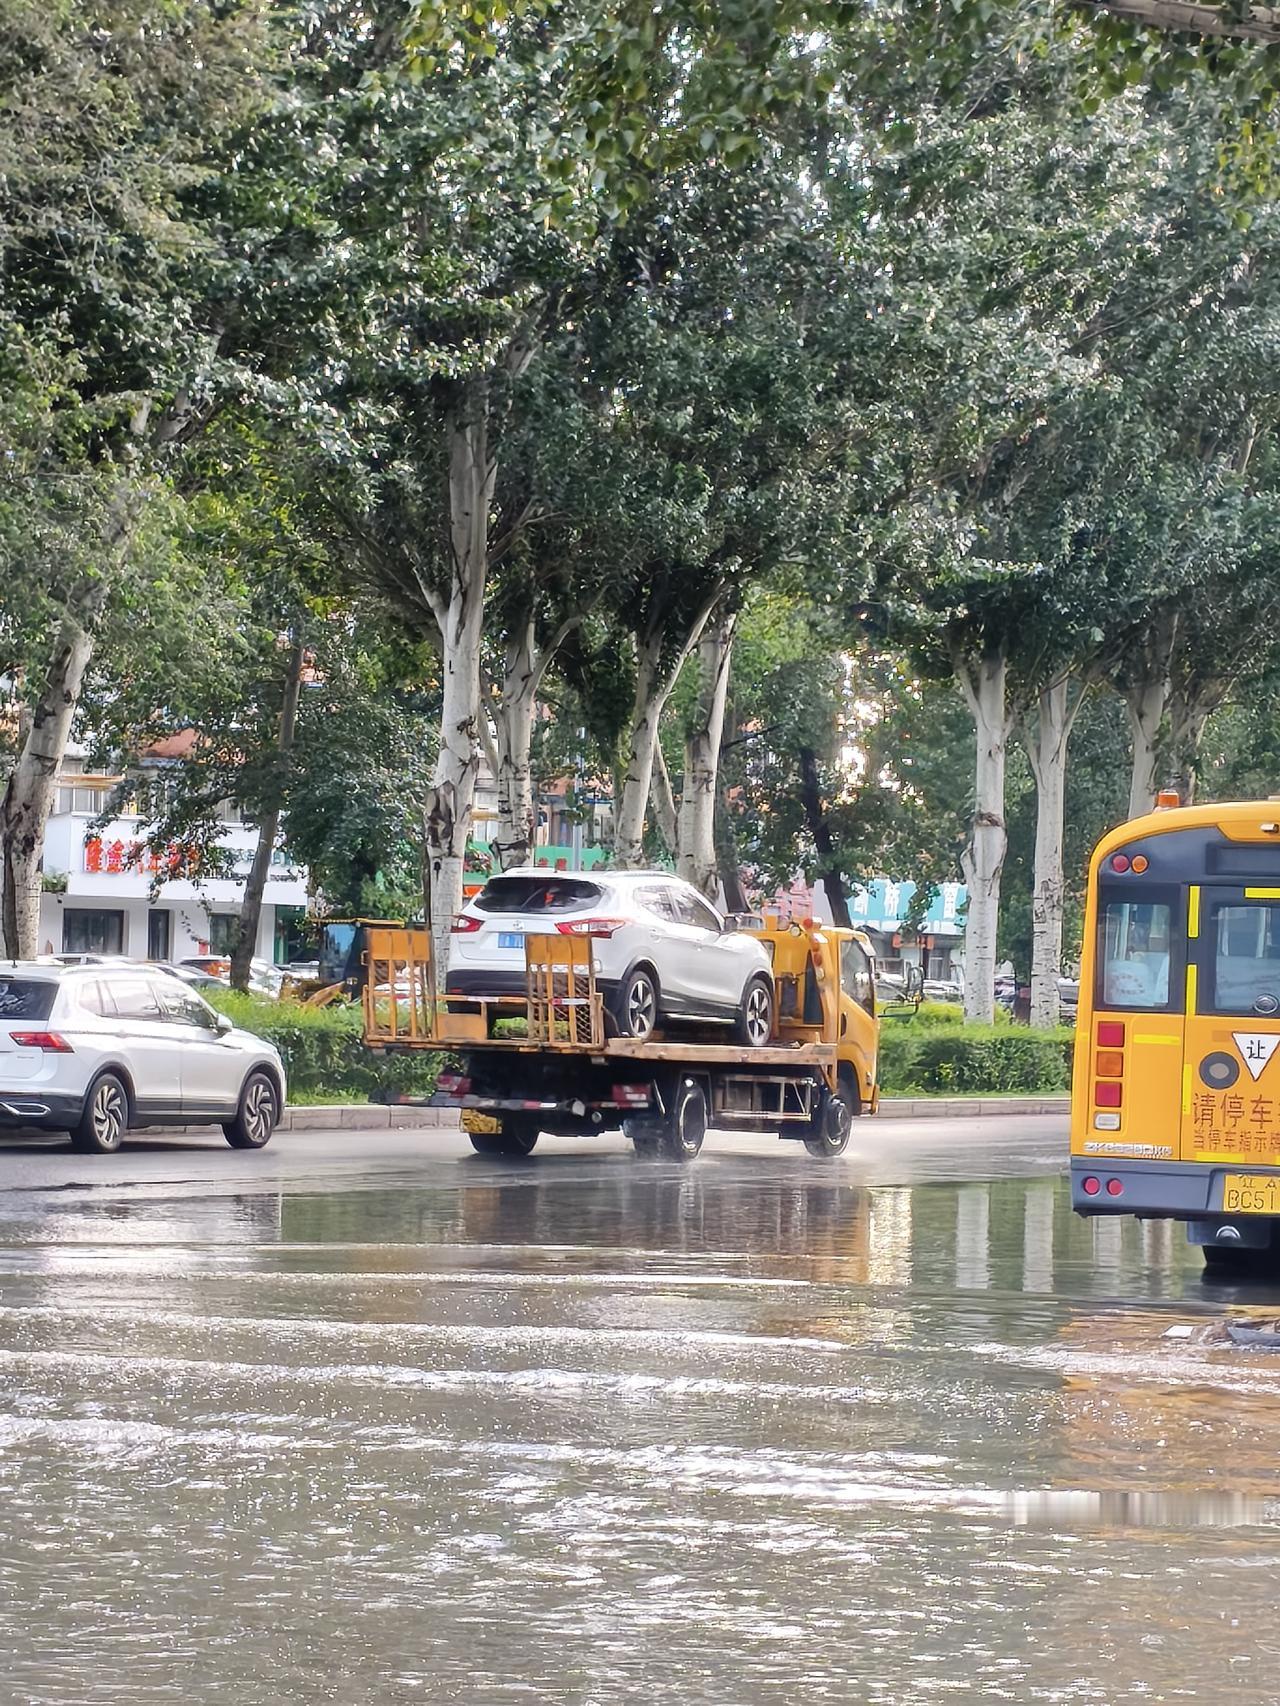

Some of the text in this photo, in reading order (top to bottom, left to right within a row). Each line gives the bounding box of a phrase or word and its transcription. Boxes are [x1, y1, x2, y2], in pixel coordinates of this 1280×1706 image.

[1246, 1039, 1266, 1060] 让
[1193, 1093, 1280, 1129] 请停车
